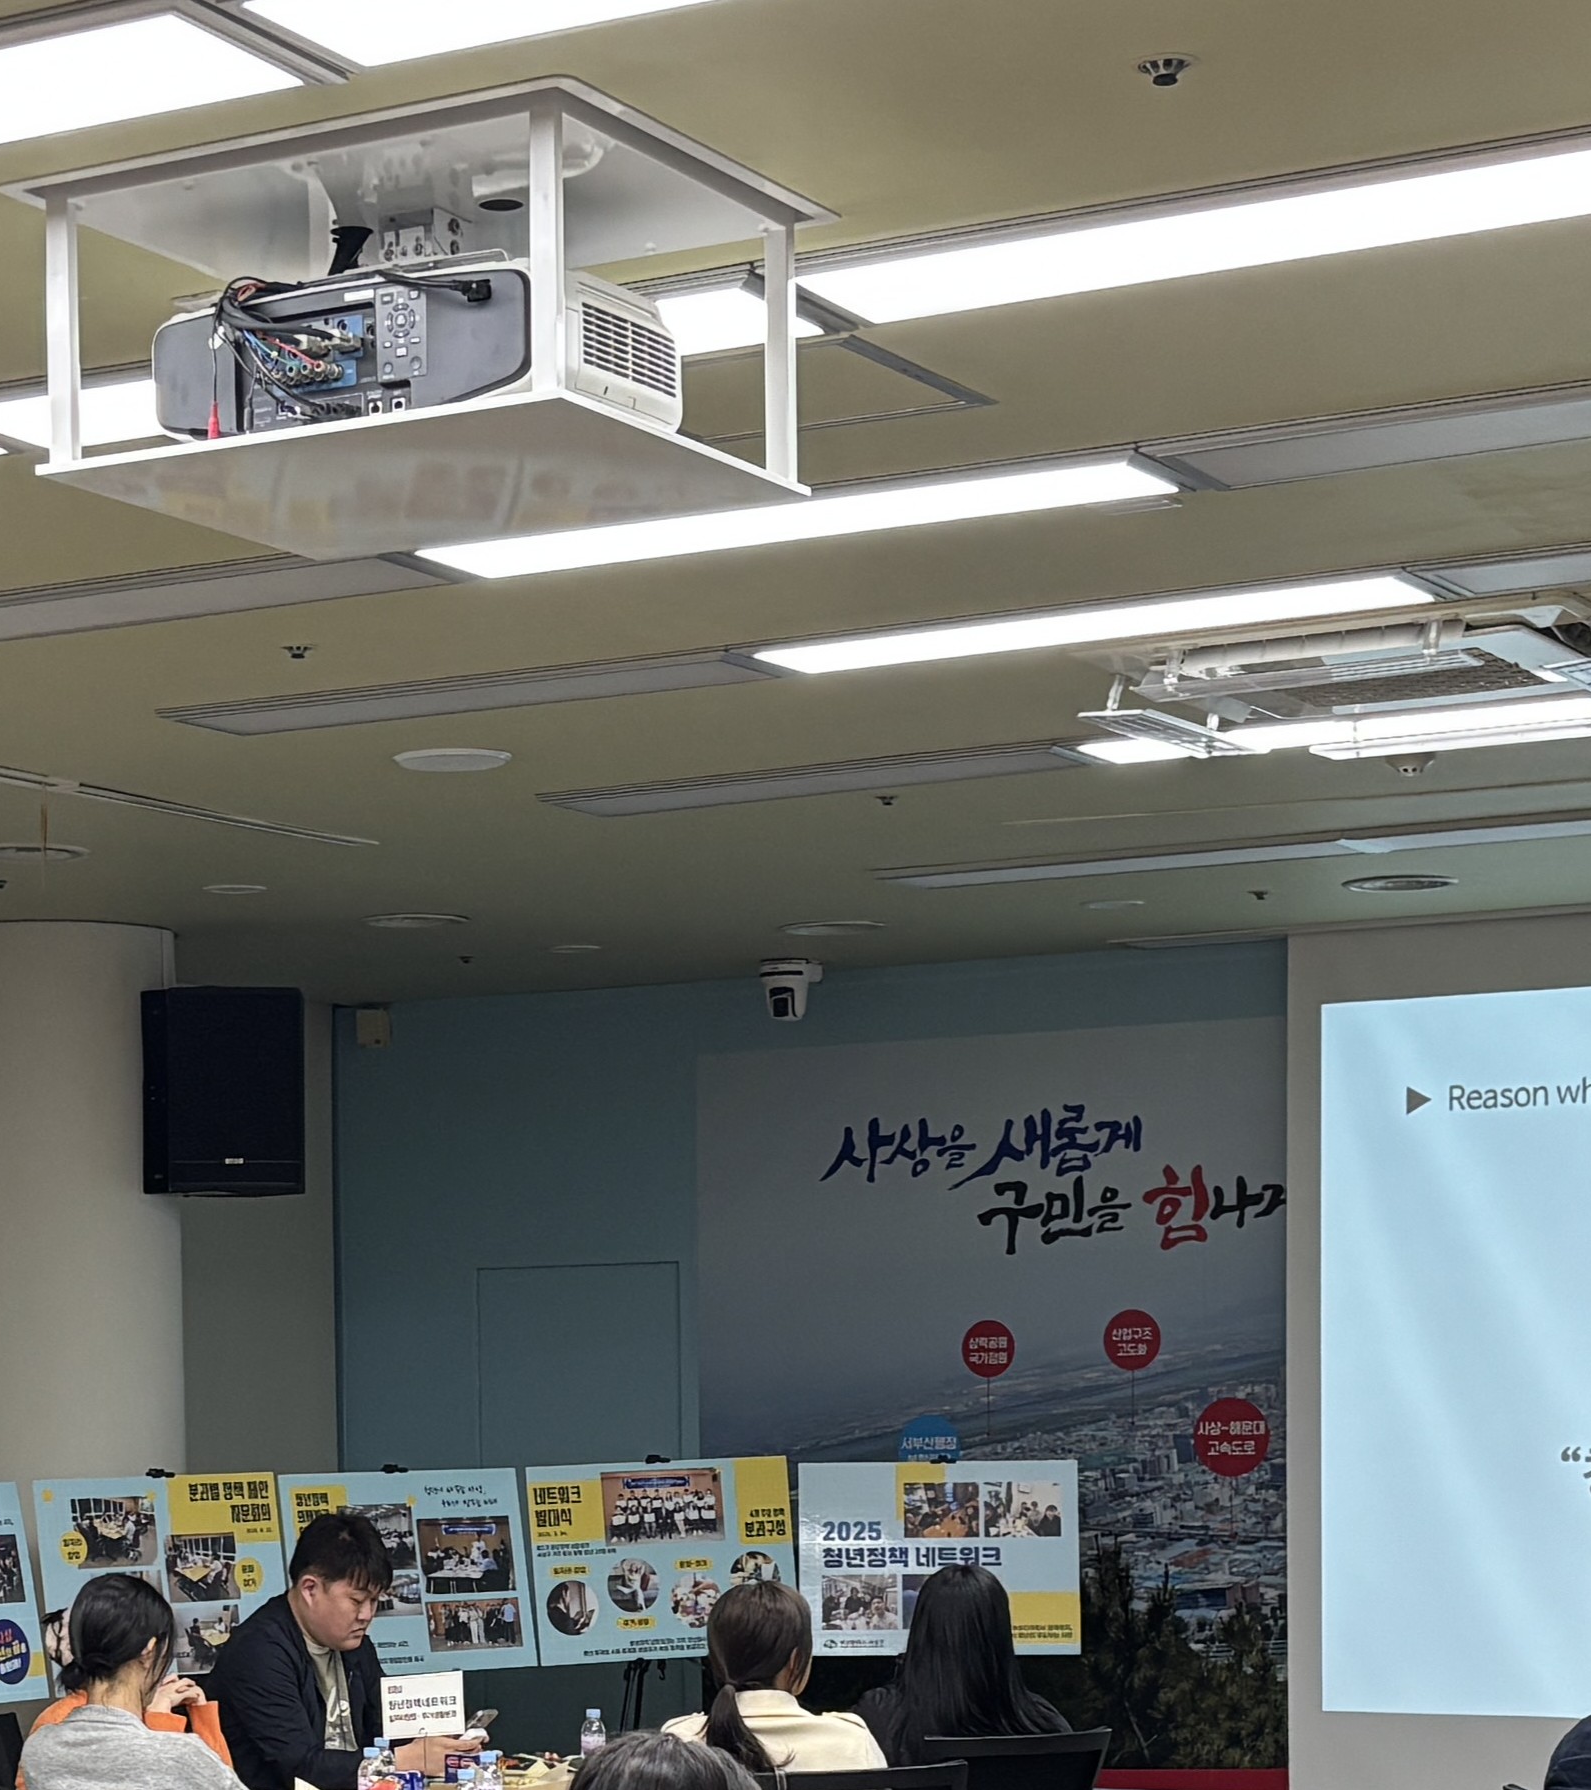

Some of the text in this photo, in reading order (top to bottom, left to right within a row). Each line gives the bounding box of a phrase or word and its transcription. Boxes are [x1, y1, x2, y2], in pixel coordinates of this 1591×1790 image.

[1448, 1084, 1549, 1112] Reason
[819, 1103, 1143, 1191] 사상을 새롭게
[977, 1175, 1133, 1256] 구민을
[1112, 1327, 1154, 1341] 산업구조
[969, 1352, 1008, 1364] 국가정원
[1207, 1440, 1256, 1456] 고속도로
[188, 1480, 269, 1502] 분과별 정책 제안
[532, 1485, 582, 1505] 네트워크
[230, 1503, 272, 1523] 자문회의
[534, 1508, 572, 1528] 발대식
[745, 1519, 786, 1537] 분과구성
[822, 1520, 882, 1541] 2025
[822, 1546, 1002, 1569] 청년정책 네트워크
